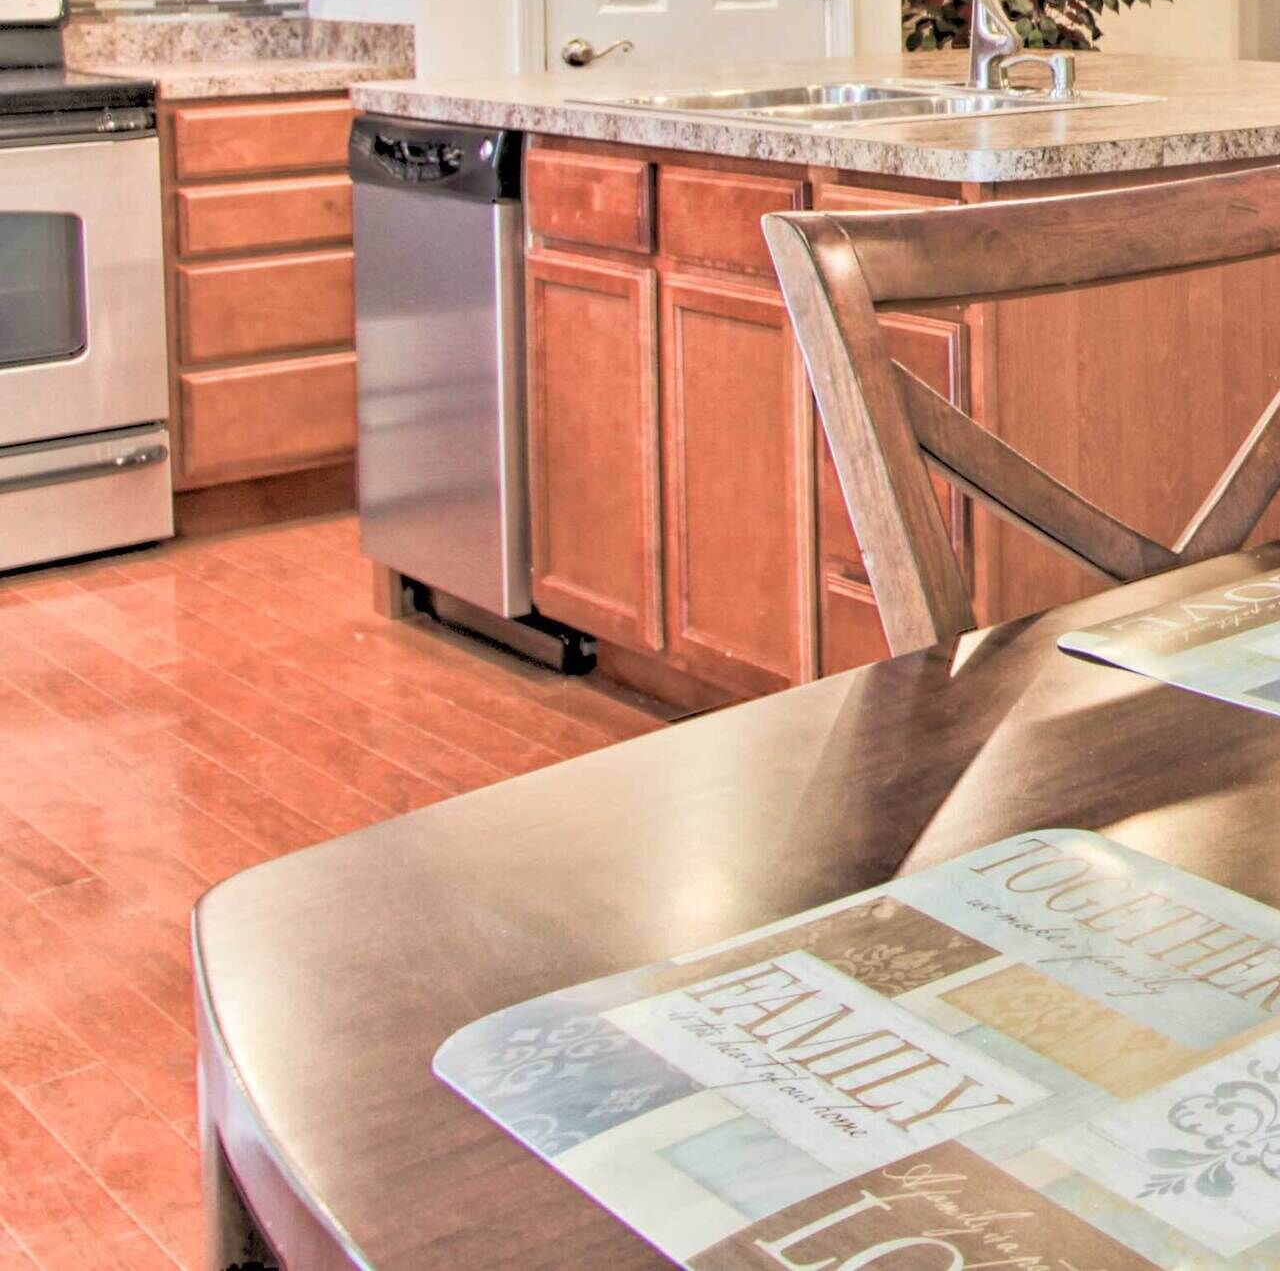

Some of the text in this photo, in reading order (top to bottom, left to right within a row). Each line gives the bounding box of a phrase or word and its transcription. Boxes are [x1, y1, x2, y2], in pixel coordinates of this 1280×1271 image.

[998, 913, 1073, 942] make
[684, 962, 1015, 1133] FAMILY
[710, 1039, 798, 1077] heart
[778, 1085, 816, 1104] our
[810, 1105, 869, 1138] home
[754, 1188, 964, 1271] LO
[882, 1189, 1036, 1238] family
